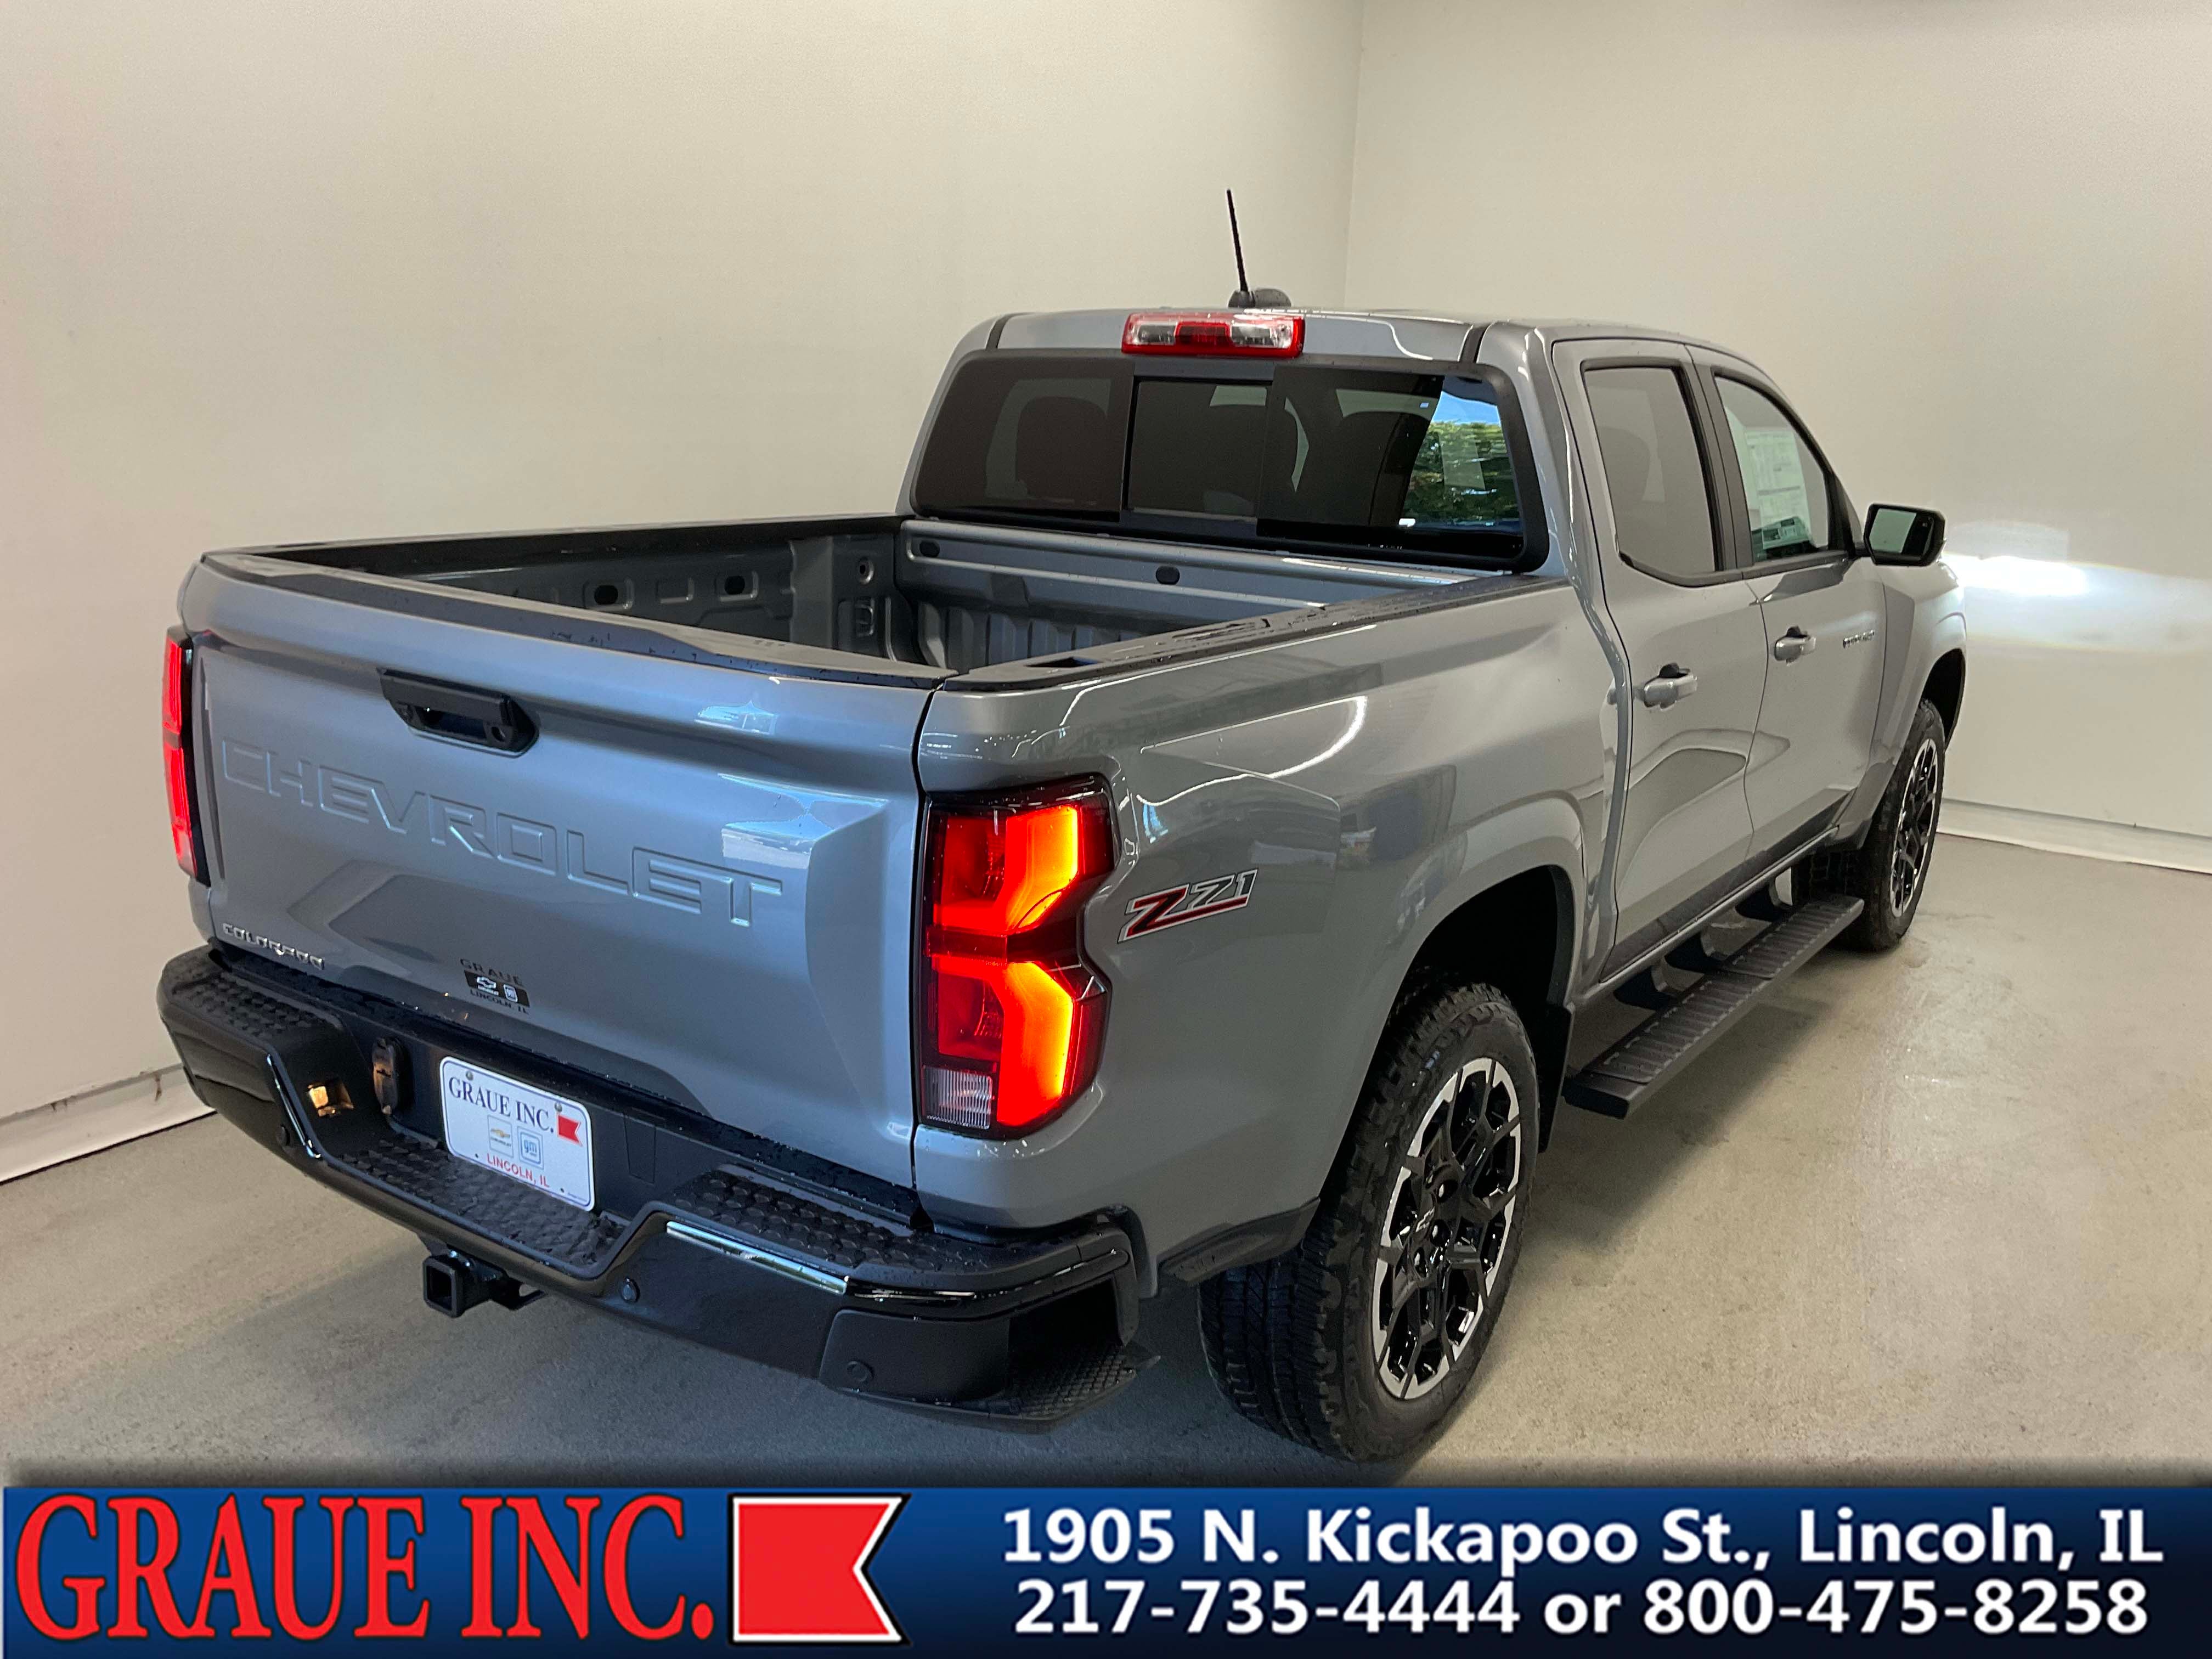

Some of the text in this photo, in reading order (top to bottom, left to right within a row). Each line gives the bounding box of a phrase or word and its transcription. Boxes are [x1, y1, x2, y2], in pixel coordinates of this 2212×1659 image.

[222, 740, 783, 928] CHEVROLET
[1117, 868, 1259, 944] Z71
[223, 923, 325, 970] COLORADO
[448, 1076, 554, 1133] GRAUE INC.
[487, 1153, 550, 1188] LINCOLN, IL
